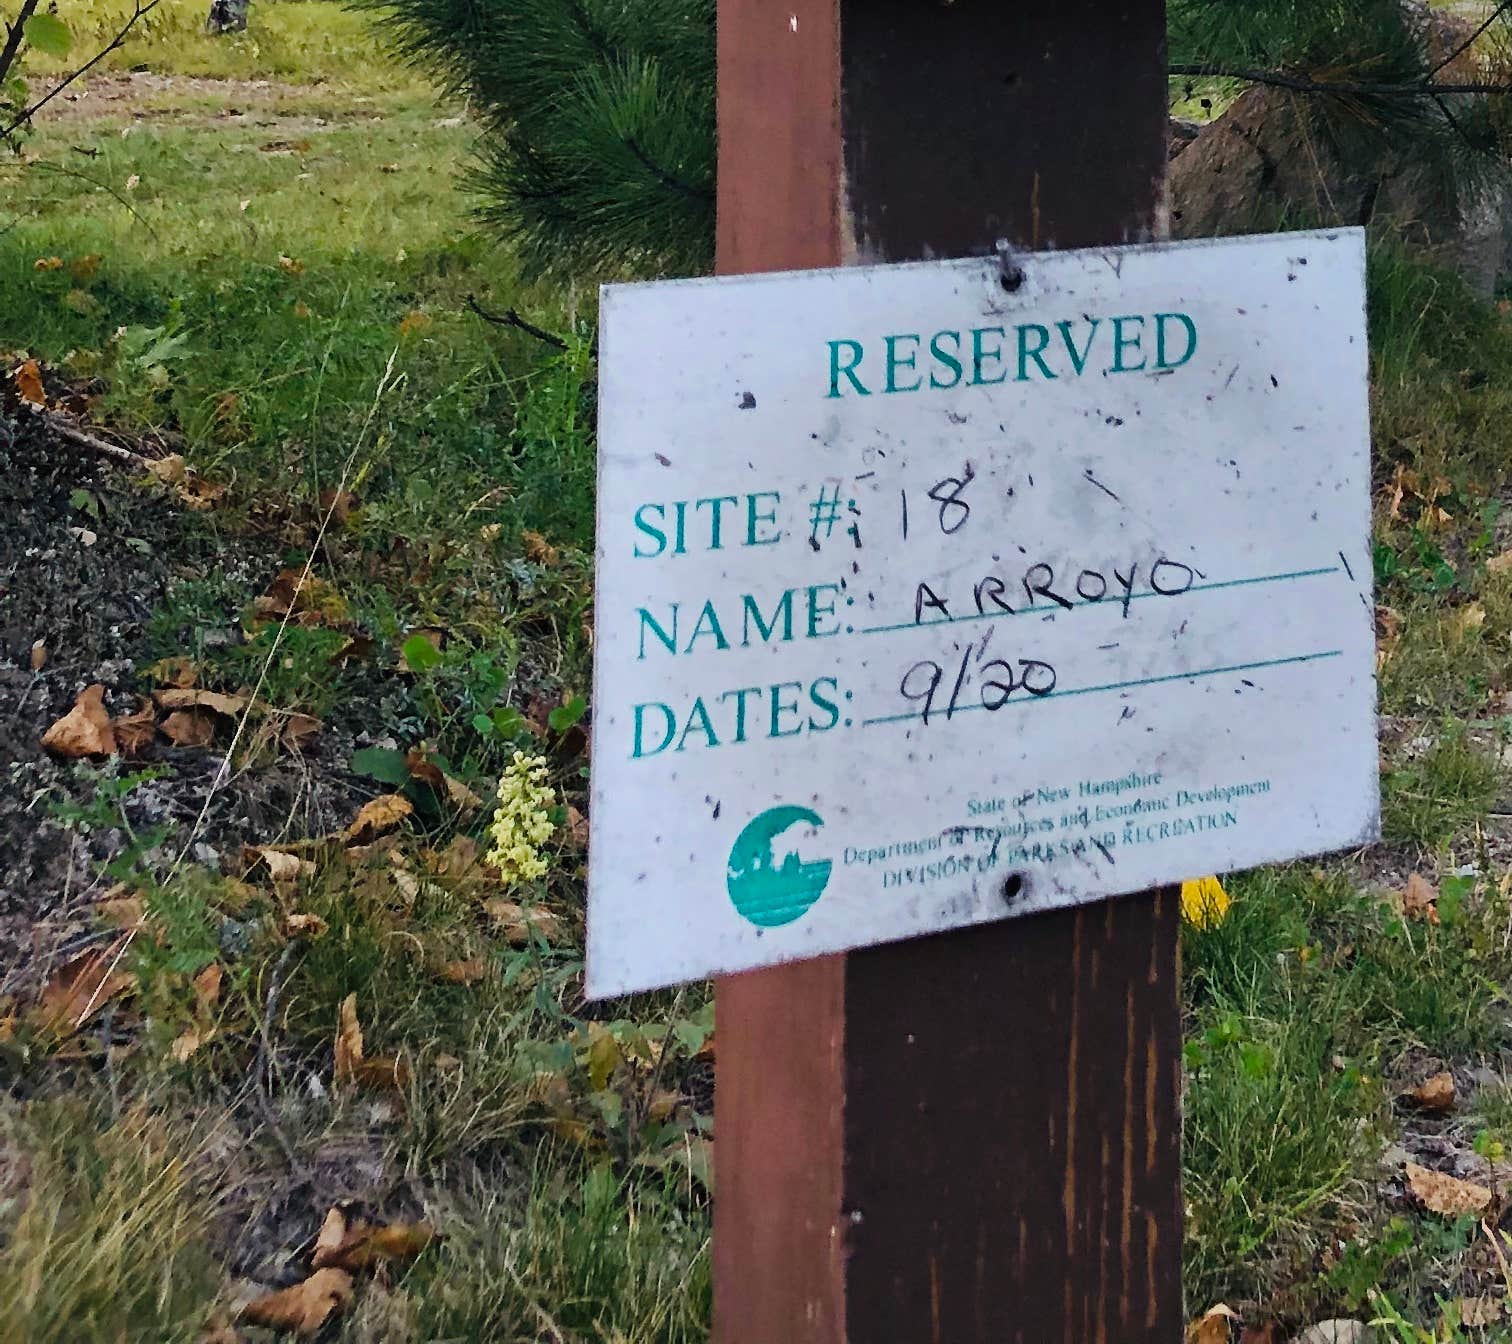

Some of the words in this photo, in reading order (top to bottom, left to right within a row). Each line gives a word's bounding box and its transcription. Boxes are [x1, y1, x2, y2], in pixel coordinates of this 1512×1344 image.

[826, 312, 1198, 399] RESERVED
[633, 490, 782, 560] SITE
[900, 470, 976, 540] 18
[634, 582, 855, 660] NAME:
[913, 558, 1195, 626] ARROYO
[628, 675, 854, 760] DATES:
[899, 642, 1057, 726] 9/20
[843, 834, 942, 865] Department
[974, 817, 1055, 842] Resources
[1060, 806, 1089, 829] and
[1095, 797, 1169, 822] Economic
[1176, 778, 1271, 807] Development
[967, 797, 1005, 818] State
[1037, 785, 1070, 805] New
[1078, 769, 1163, 798] Hampshire
[882, 855, 970, 889] DIVISION
[1008, 840, 1068, 867] PARKS
[1122, 809, 1238, 845] RECREATION
